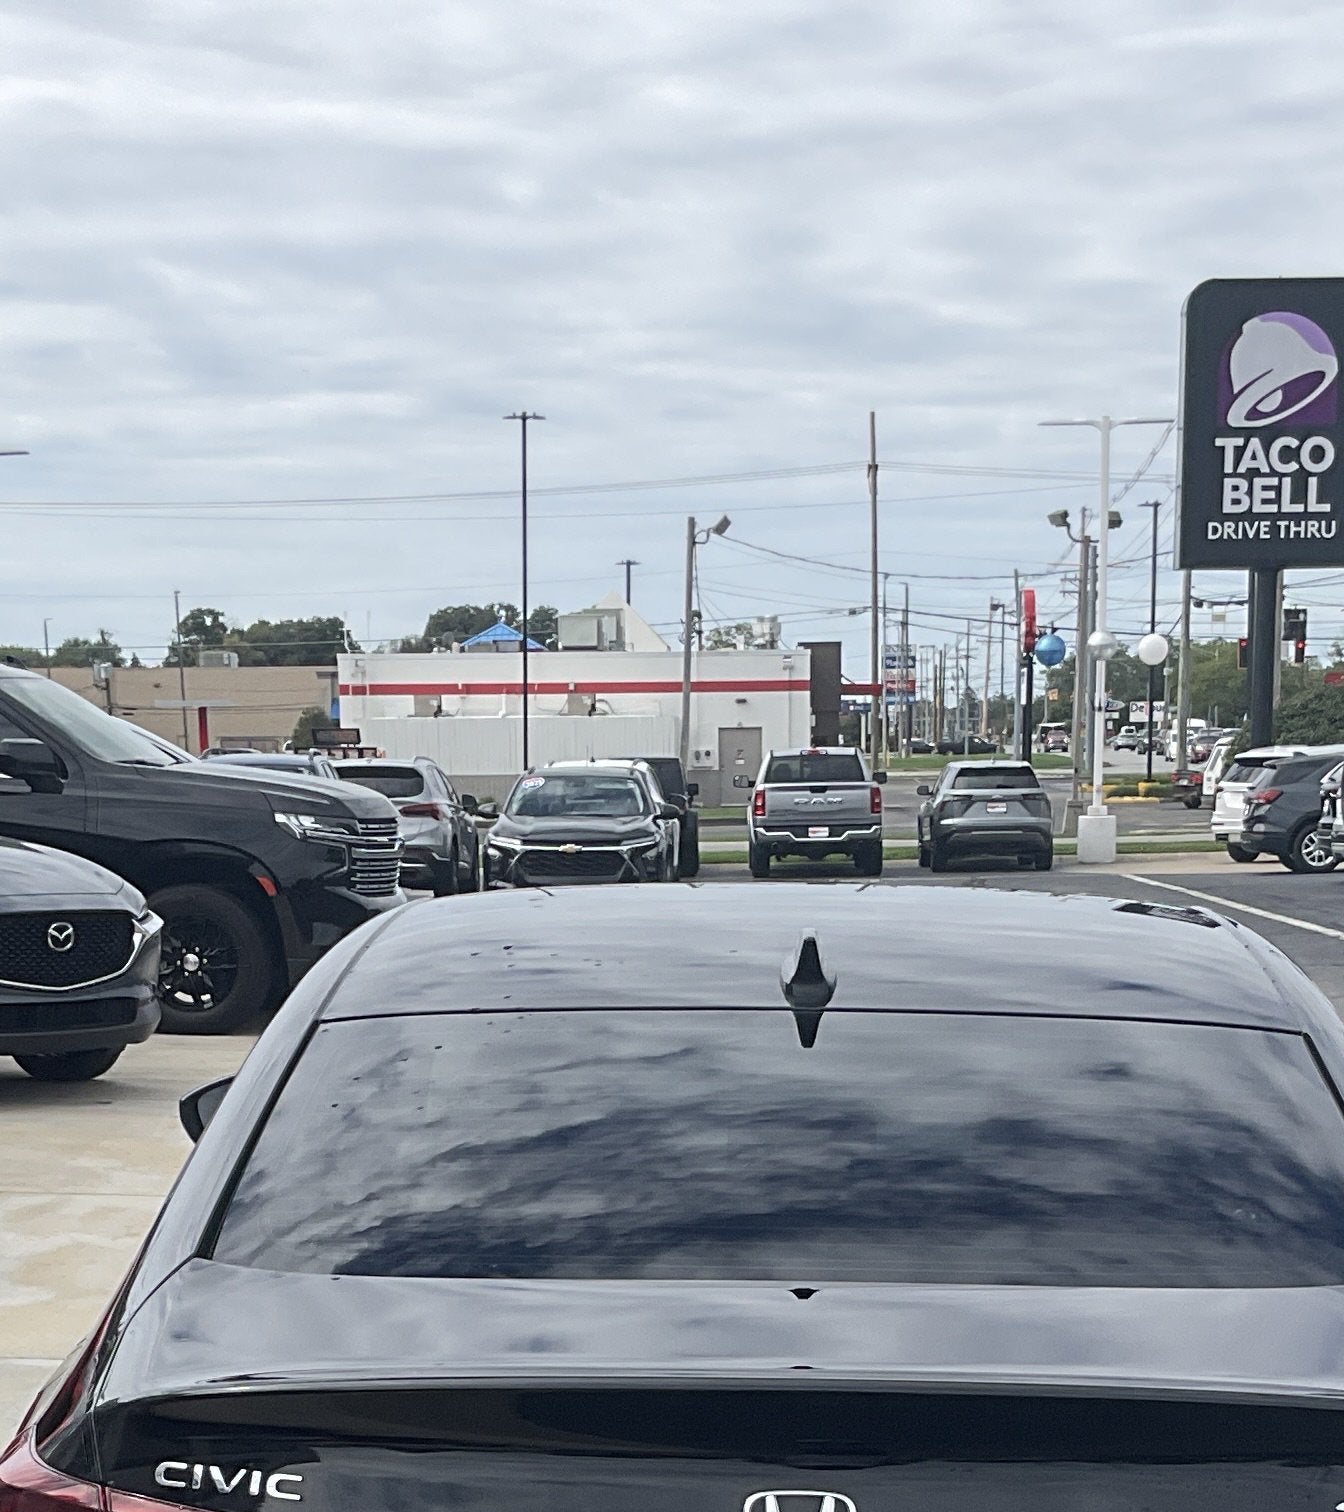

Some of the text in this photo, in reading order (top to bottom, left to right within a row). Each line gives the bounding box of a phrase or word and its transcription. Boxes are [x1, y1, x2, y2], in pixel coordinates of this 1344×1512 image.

[1214, 435, 1335, 475] TACO
[1221, 475, 1332, 515] BELL
[1207, 519, 1337, 541] DRIVE THRU
[155, 1460, 304, 1502] CIVIC
